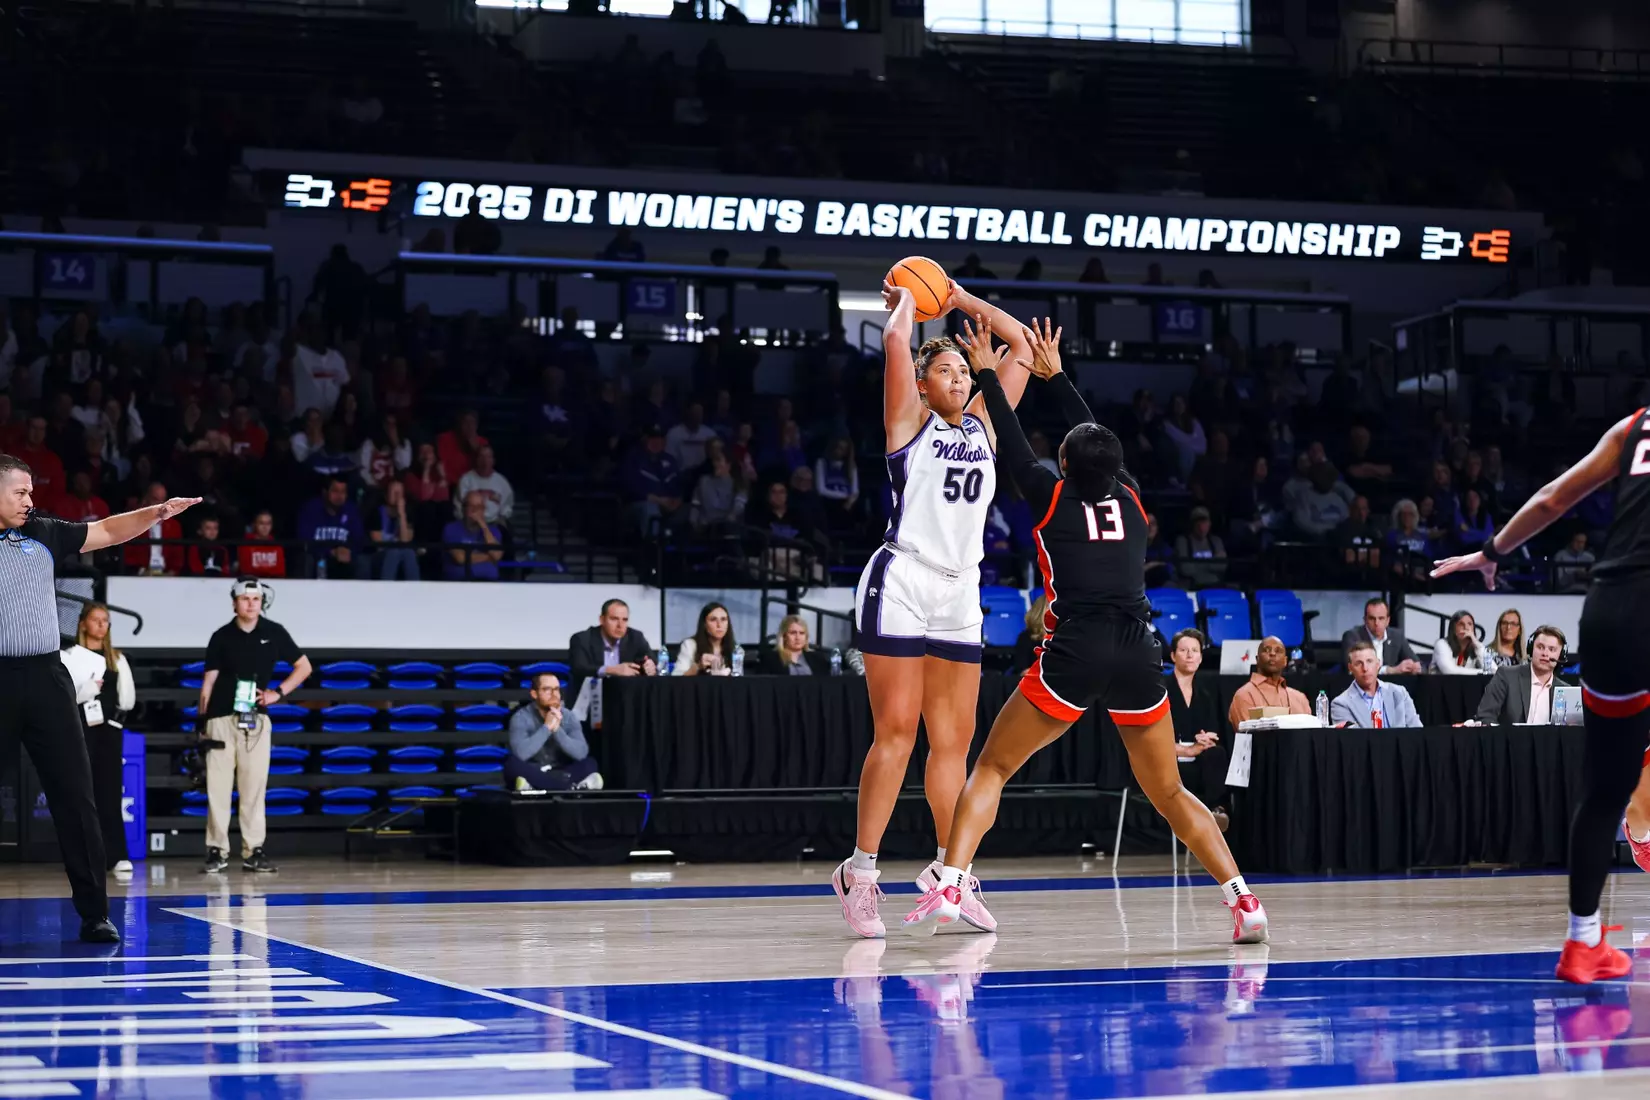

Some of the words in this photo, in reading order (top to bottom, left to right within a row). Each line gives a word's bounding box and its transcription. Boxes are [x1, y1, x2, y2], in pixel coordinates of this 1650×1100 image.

[413, 181, 533, 221] 2025
[542, 187, 598, 224] DI
[608, 191, 805, 234] WOMEN'S
[814, 201, 1073, 245] BASKETBALL
[1083, 213, 1401, 258] CHAMPIONSHIP
[49, 257, 86, 284] 14
[634, 284, 667, 309] 15
[1165, 307, 1196, 330] 16
[943, 466, 984, 505] 50
[1081, 498, 1126, 543] 13
